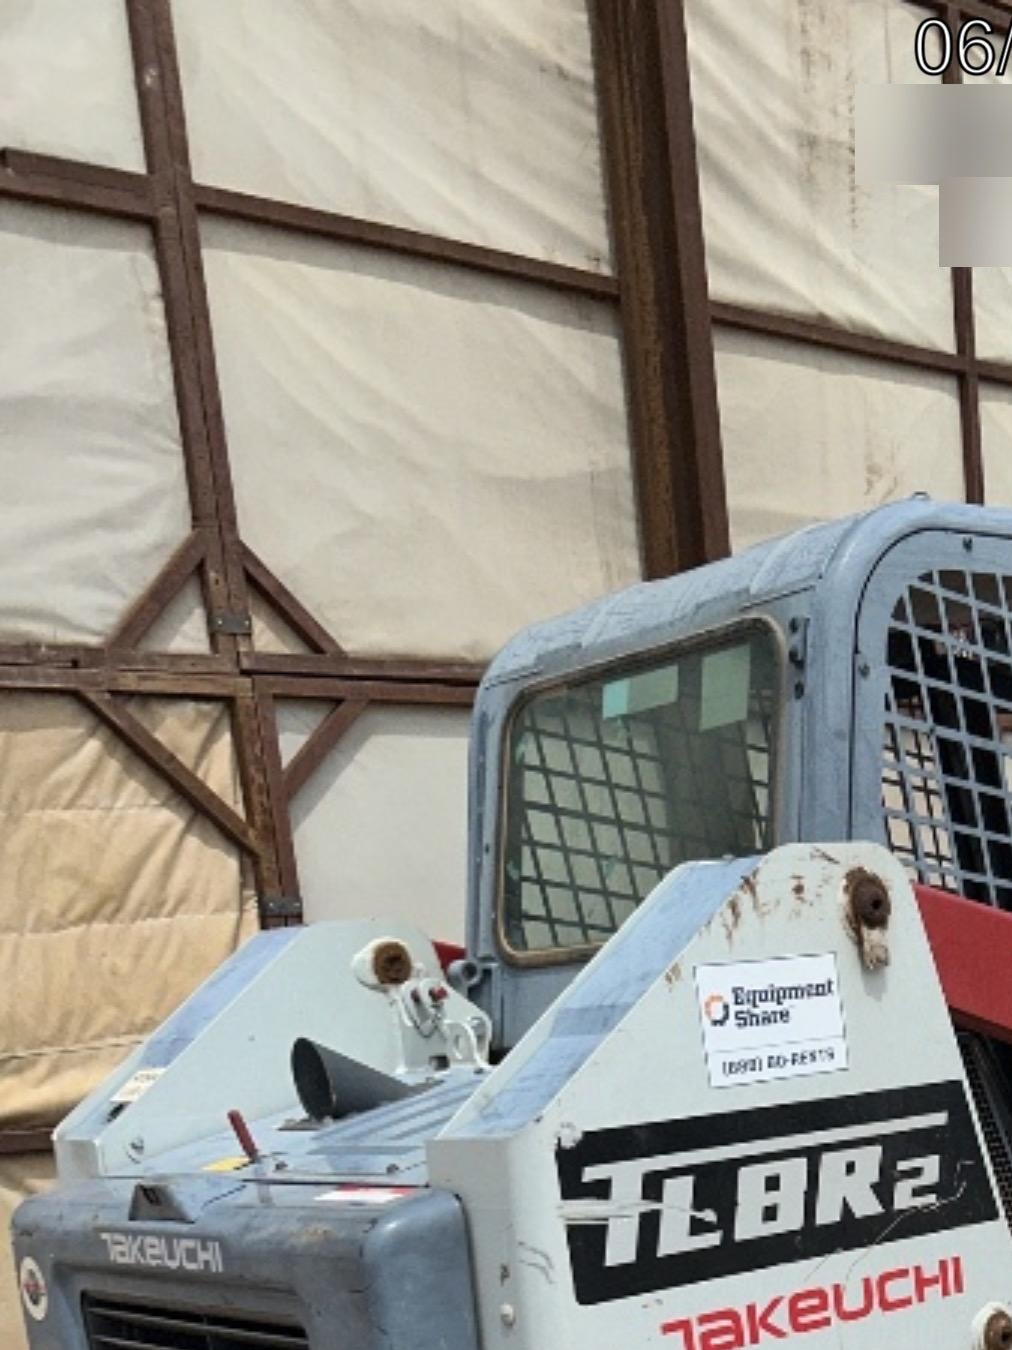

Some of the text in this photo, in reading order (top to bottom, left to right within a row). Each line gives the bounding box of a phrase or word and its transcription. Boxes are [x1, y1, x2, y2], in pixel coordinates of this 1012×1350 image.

[731, 978, 833, 1008] Equipment
[733, 1008, 790, 1028] Share
[581, 1111, 949, 1266] TL8R2
[100, 1232, 223, 1273] TAKEUCHI
